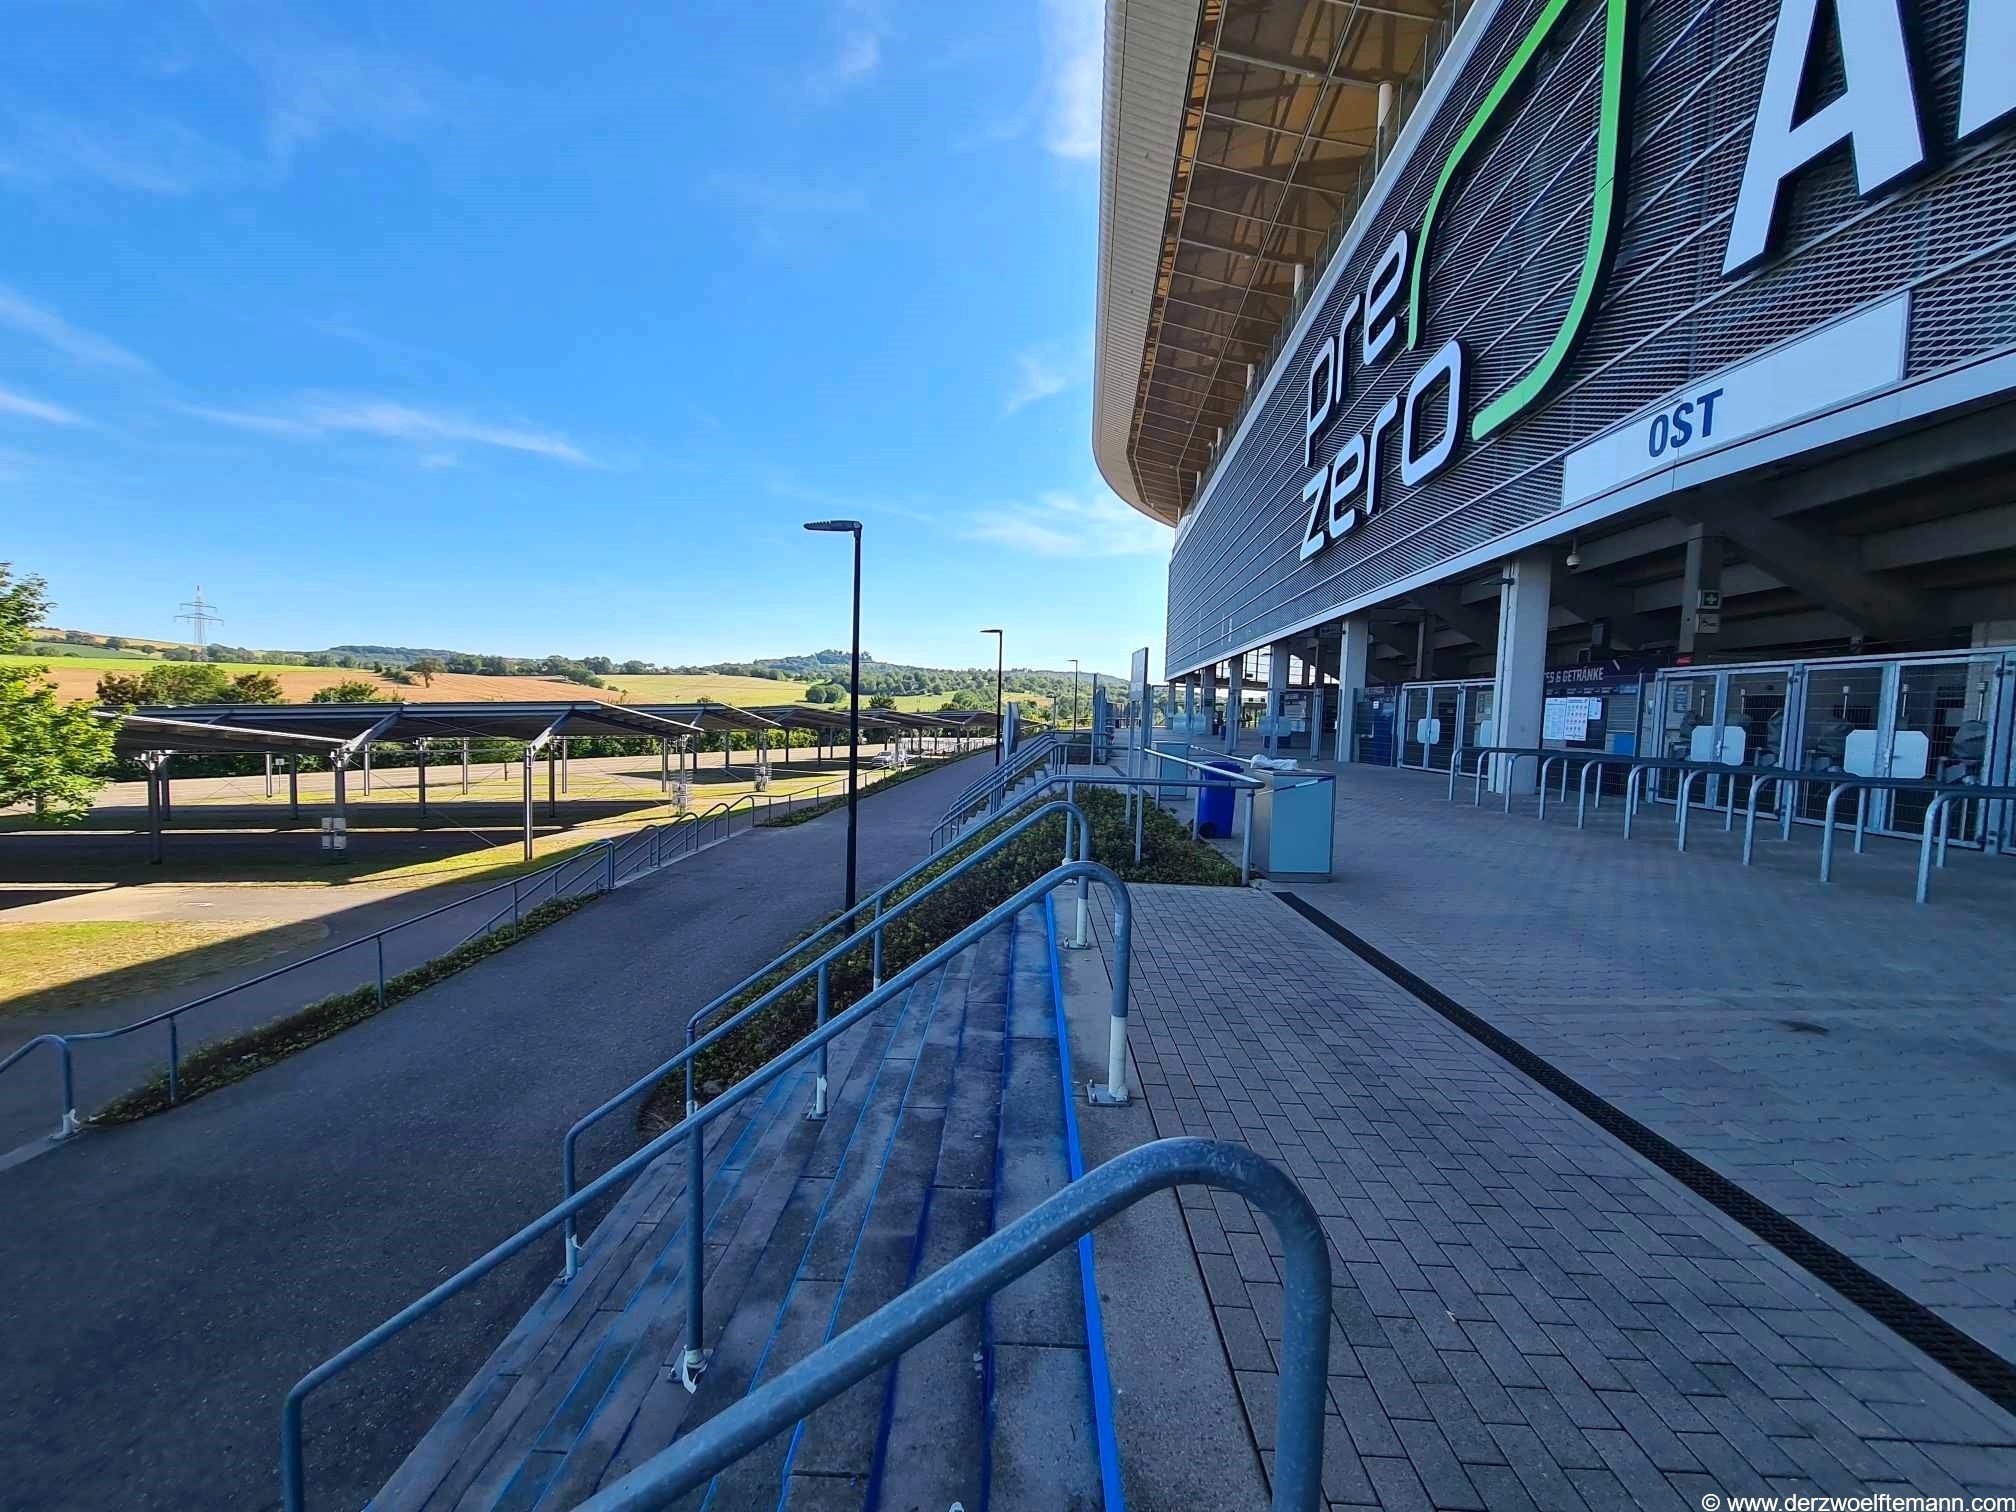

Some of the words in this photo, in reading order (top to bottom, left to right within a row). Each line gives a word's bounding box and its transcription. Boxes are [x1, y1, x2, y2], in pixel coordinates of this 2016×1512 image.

[1305, 230, 1407, 466] pre
[1300, 340, 1461, 561] zero
[1649, 388, 1723, 457] OST
[1562, 666, 1604, 681] GETRÄNKE
